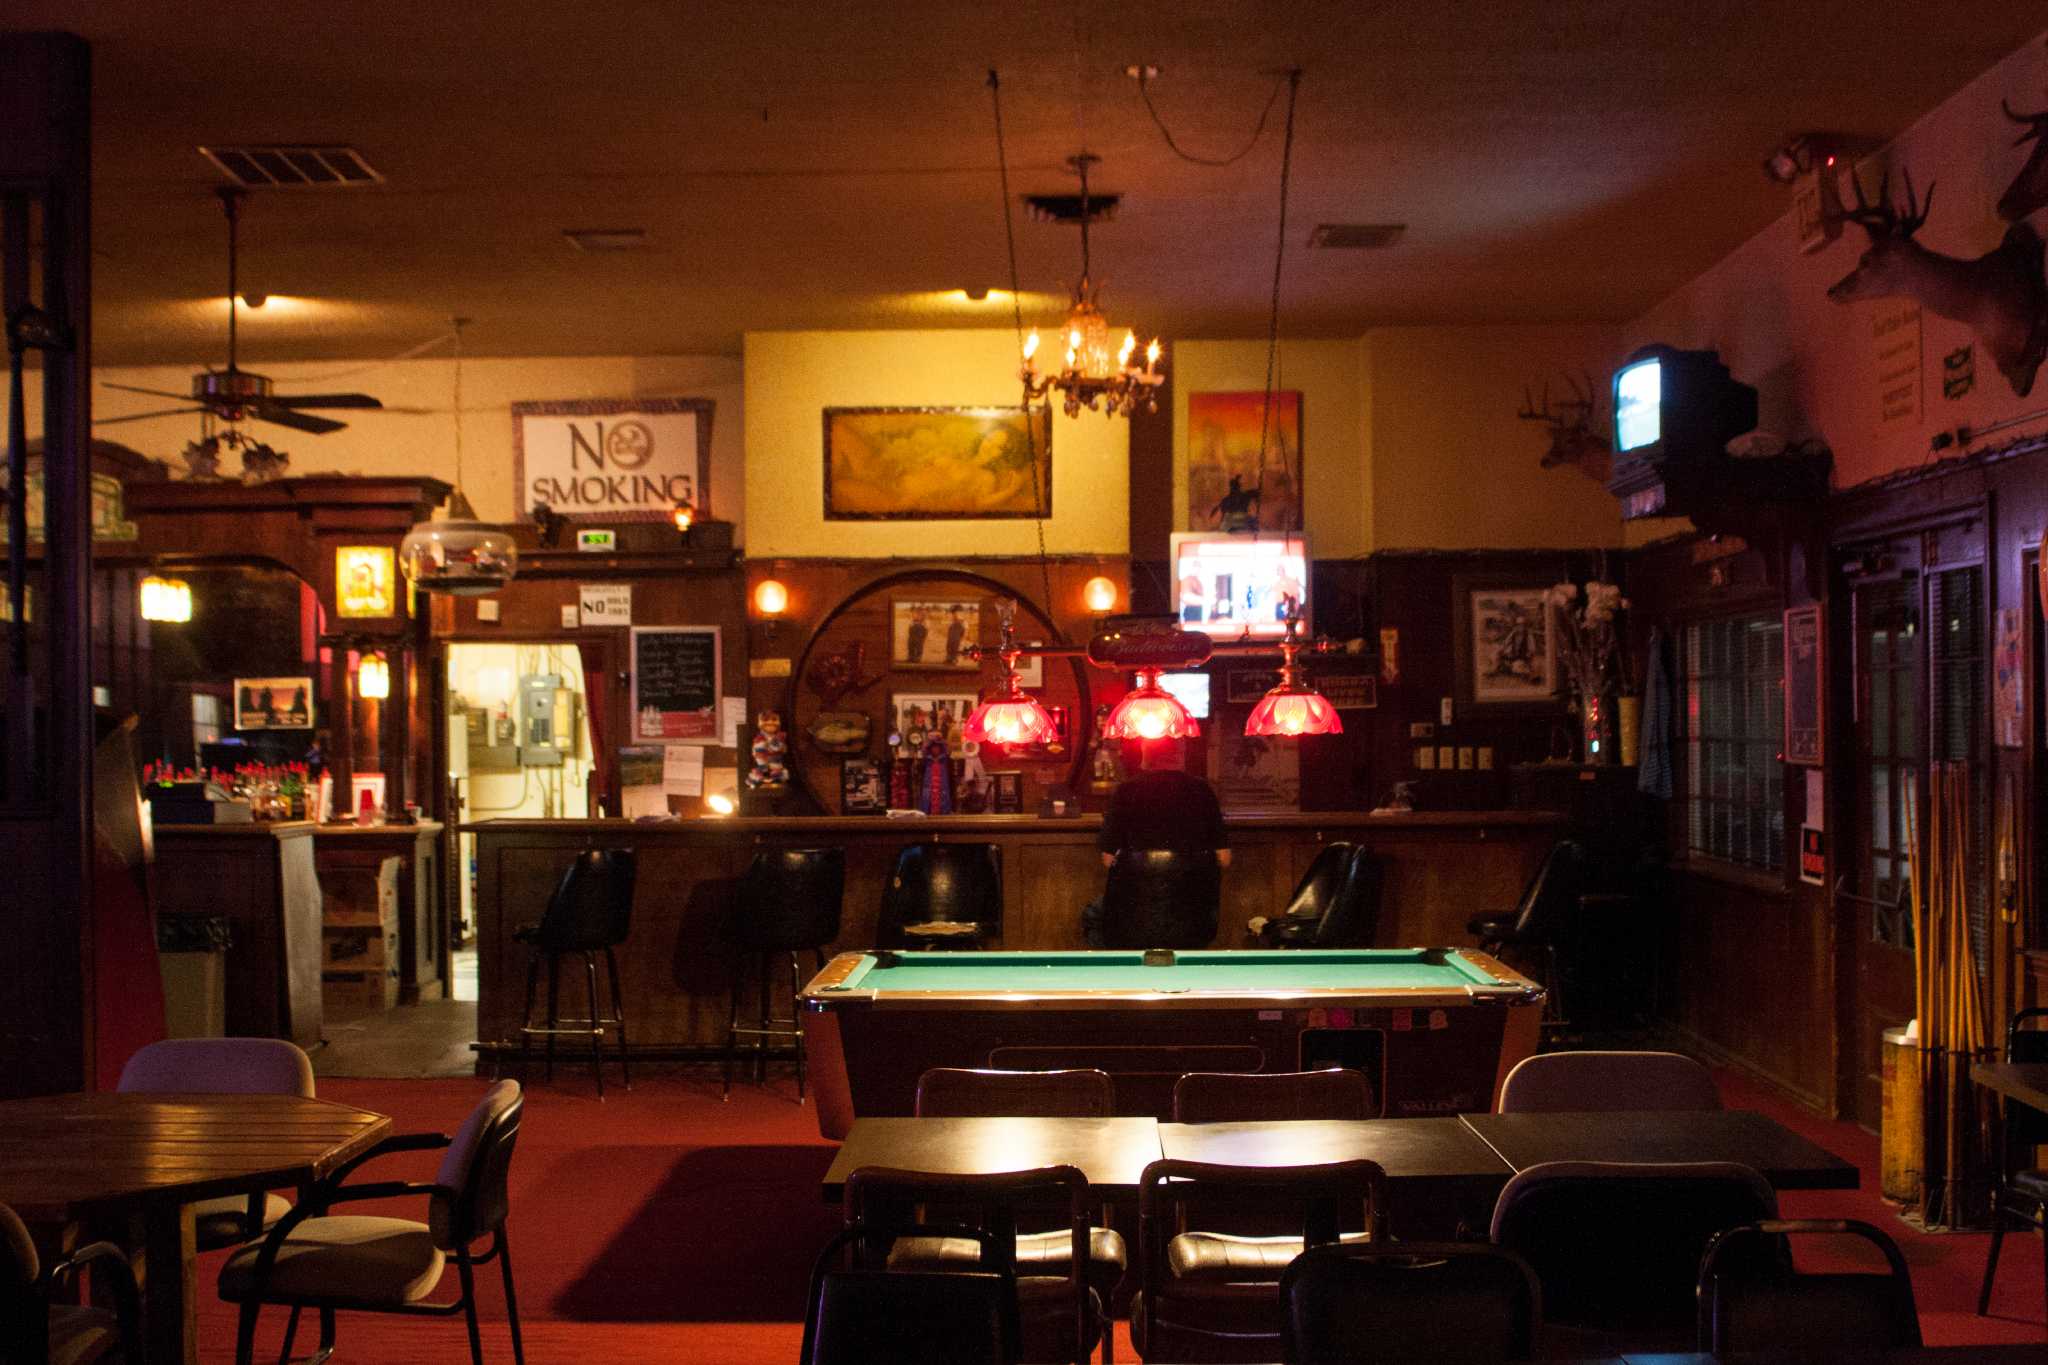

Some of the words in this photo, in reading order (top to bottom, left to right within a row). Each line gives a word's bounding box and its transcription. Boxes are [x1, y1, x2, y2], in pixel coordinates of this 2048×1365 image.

[568, 420, 654, 470] NO
[533, 475, 691, 505] SMOKING
[583, 600, 605, 614] NO
